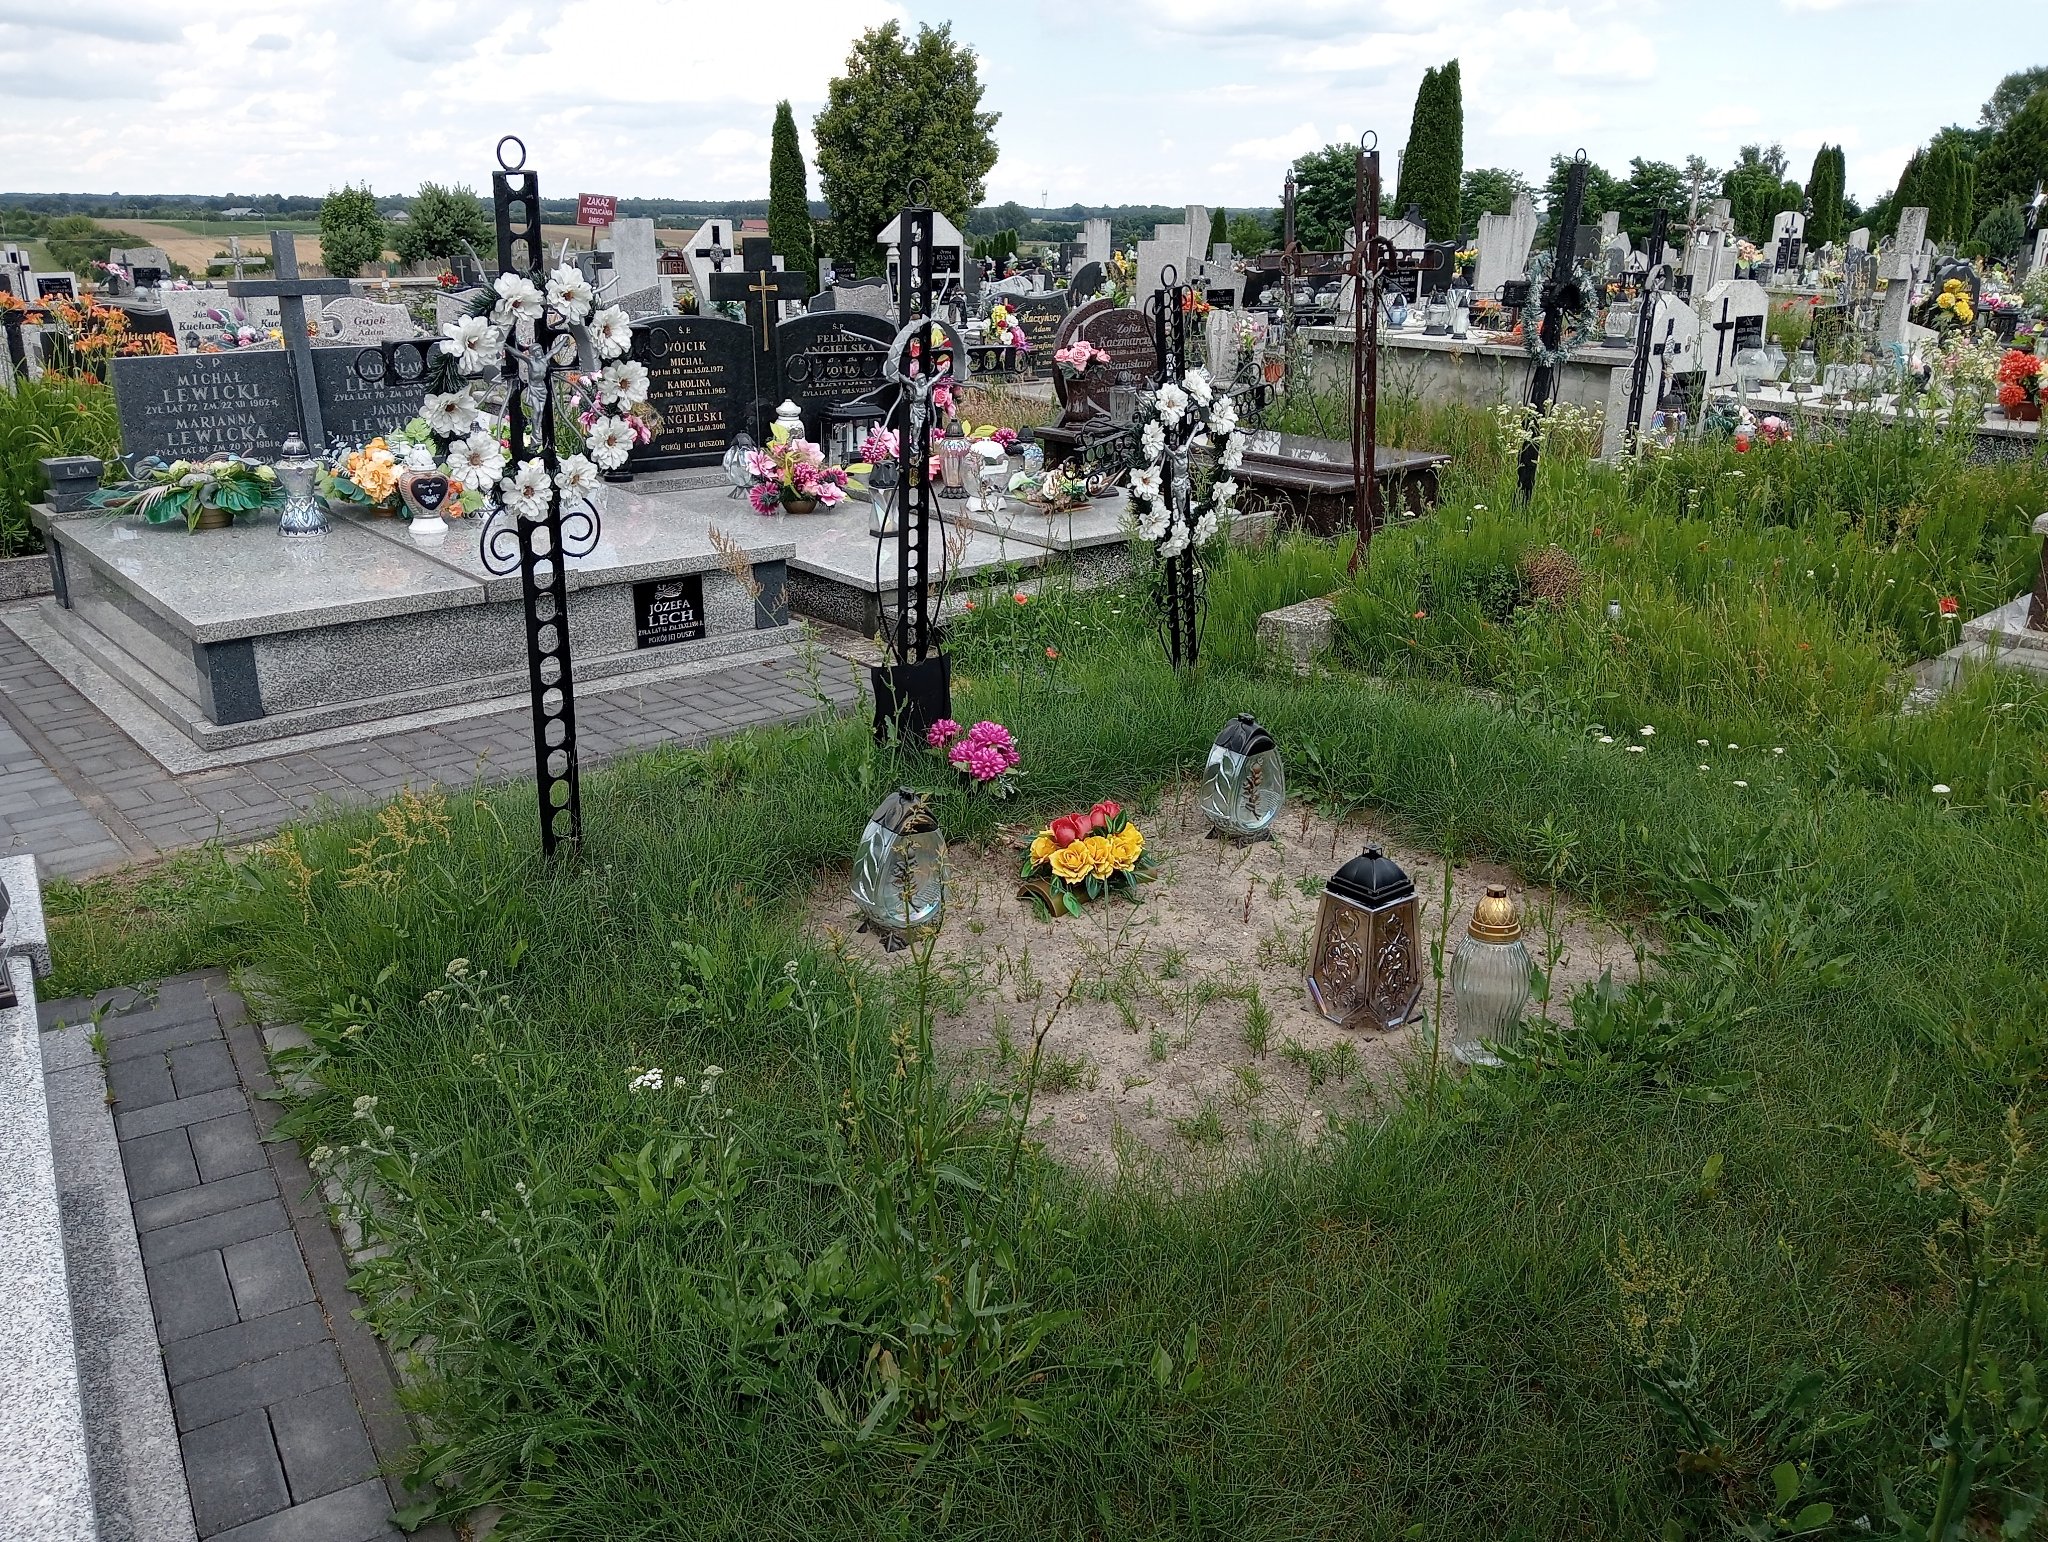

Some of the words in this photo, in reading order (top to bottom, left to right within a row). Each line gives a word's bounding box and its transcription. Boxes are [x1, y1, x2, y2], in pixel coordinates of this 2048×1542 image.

[587, 197, 609, 207] ZAKAZ
[582, 207, 613, 216] WYRZUCANIA
[354, 316, 386, 326] Gajek
[1117, 323, 1141, 335] Zofia
[177, 371, 243, 387] MICHAŁ
[667, 379, 711, 389] KAROLINA
[162, 383, 260, 403] LEWICKI
[358, 392, 371, 400] LAT
[167, 405, 182, 413] LAT
[221, 401, 233, 409] 22
[371, 401, 419, 416] JANINA
[668, 402, 709, 414] ZYGMUNT
[176, 413, 257, 430] MARIANNA
[167, 425, 268, 446] LEWICKA
[661, 442, 681, 451] POKÓJ
[699, 440, 725, 448] DUSZOM
[650, 600, 690, 615] JÓZEFA
[648, 610, 693, 626] LECH
[649, 634, 667, 643] POKÓJ
[677, 630, 695, 638] DUSZY
